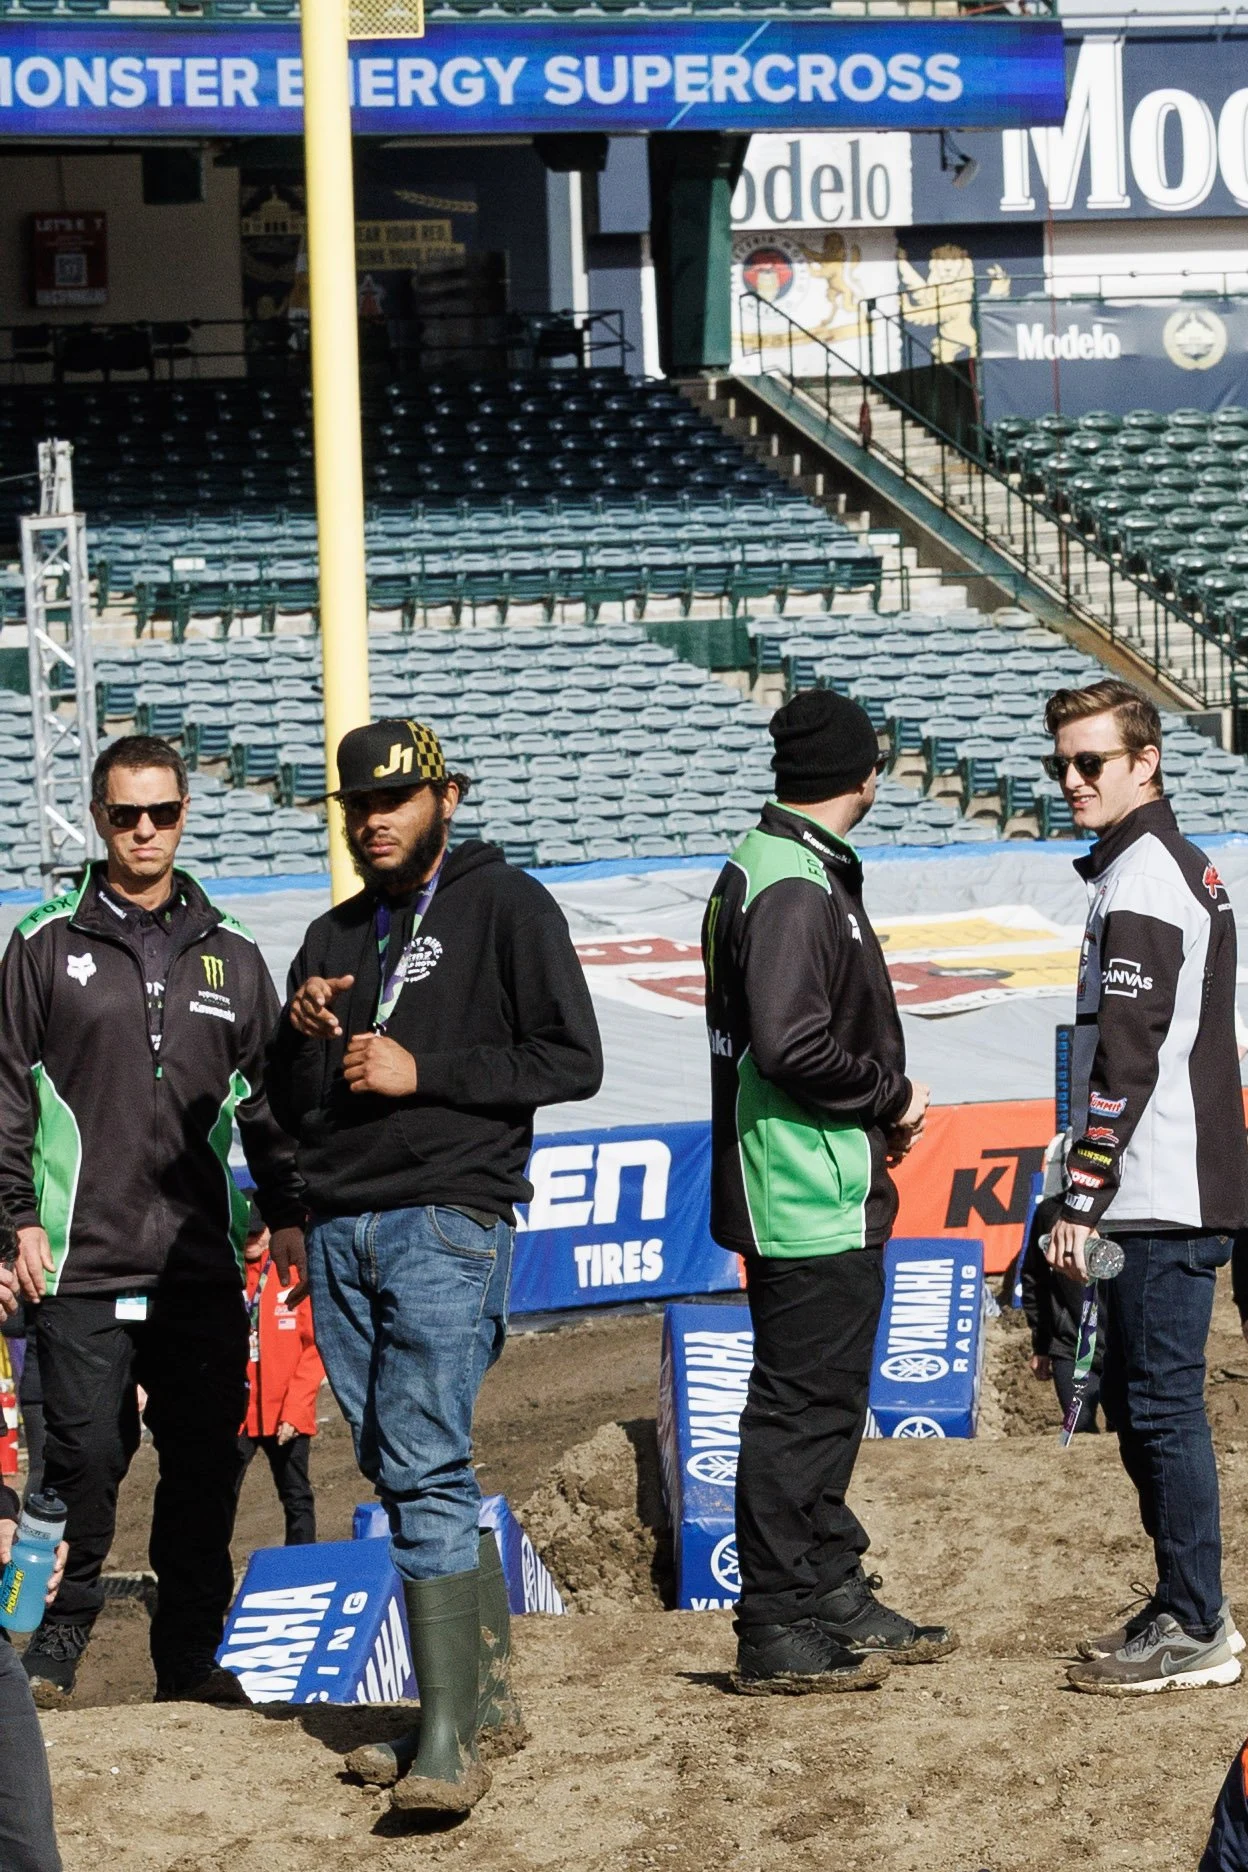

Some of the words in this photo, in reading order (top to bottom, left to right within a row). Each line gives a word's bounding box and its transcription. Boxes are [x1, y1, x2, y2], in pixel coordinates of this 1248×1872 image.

[278, 55, 528, 107] EERGY
[543, 54, 964, 105] SUPERCROSS
[731, 139, 891, 223] odelo
[1016, 322, 1122, 361] Modelo
[28, 898, 73, 923] FOX
[943, 1145, 1051, 1230] KT
[573, 1238, 665, 1289] TIRES
[887, 1258, 954, 1355] YAMAHA
[953, 1265, 978, 1374] RACING
[683, 1330, 755, 1449] YAMAHA
